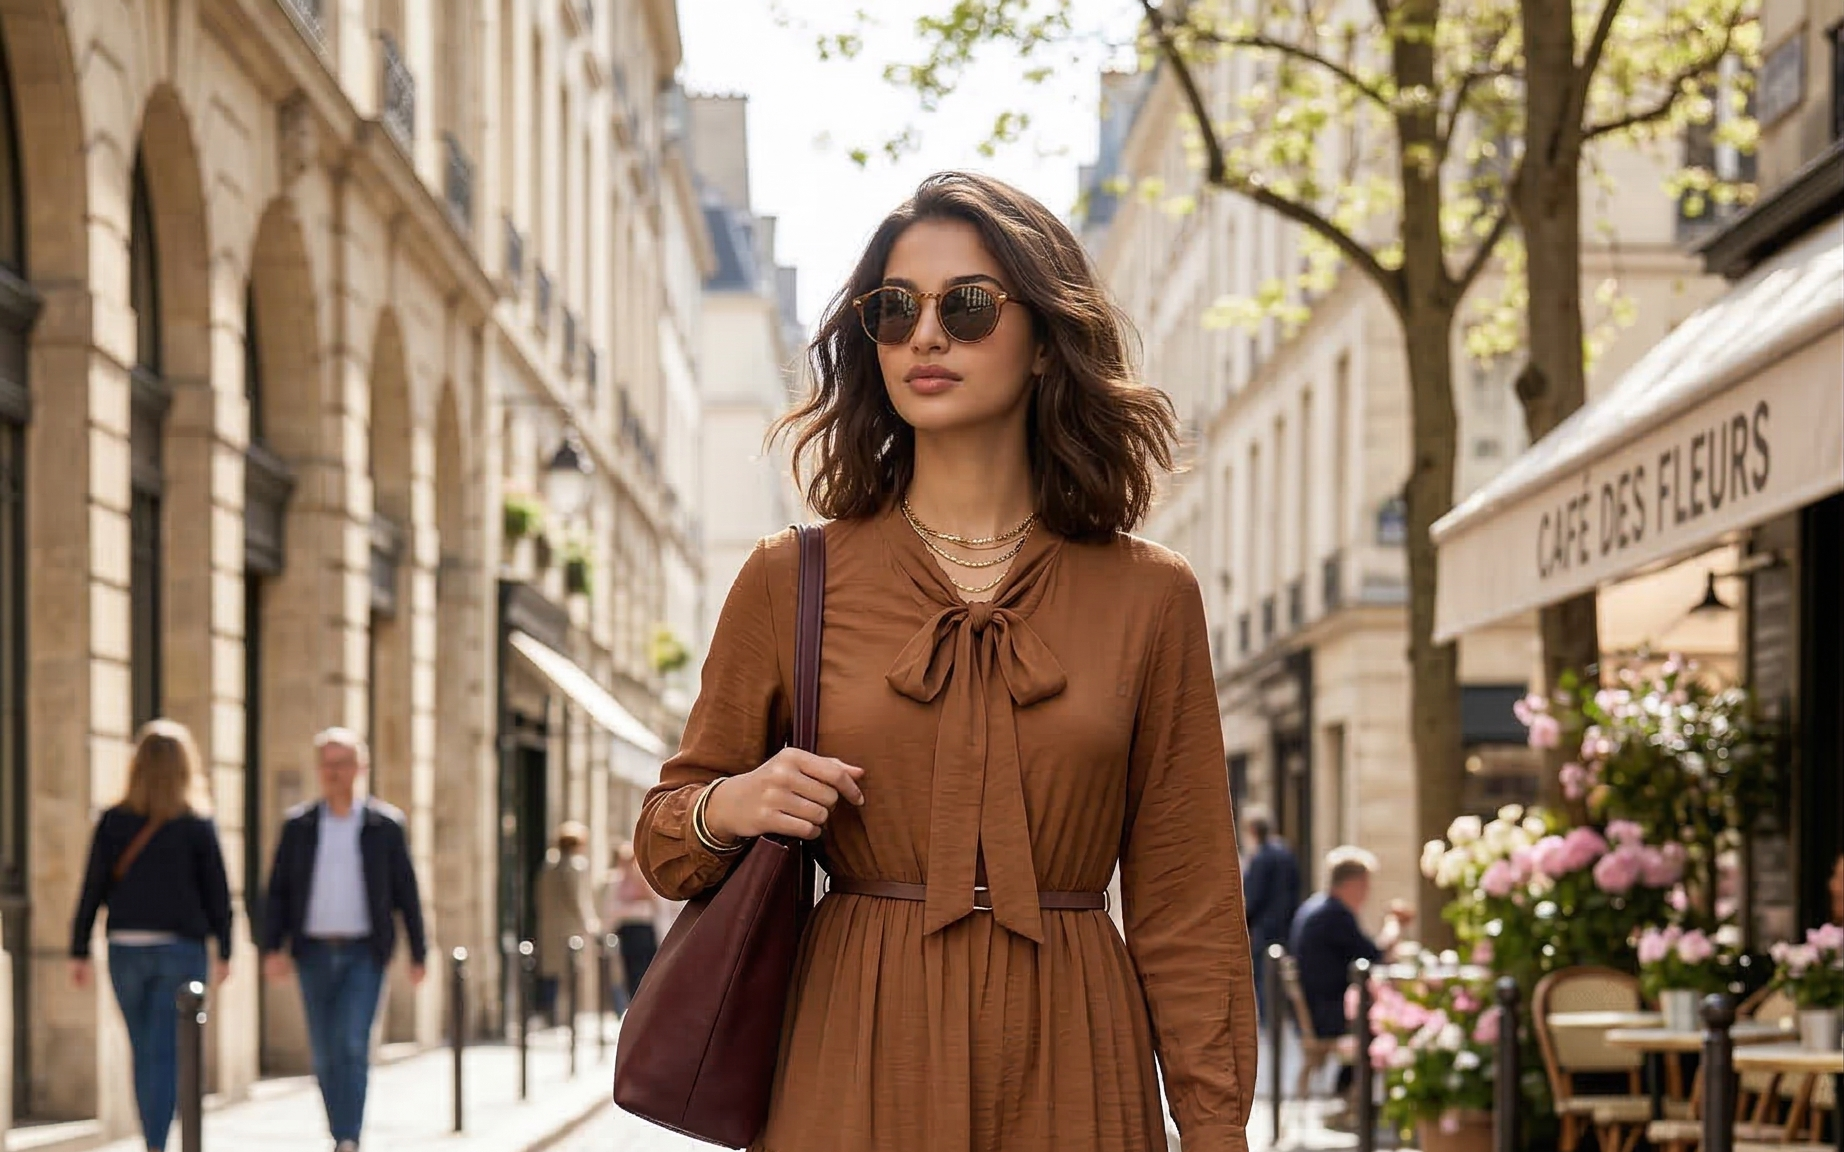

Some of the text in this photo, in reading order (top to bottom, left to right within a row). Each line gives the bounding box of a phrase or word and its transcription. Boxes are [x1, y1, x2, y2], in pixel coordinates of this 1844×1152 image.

[1537, 400, 1769, 578] CAFÉ DES FLEURS
